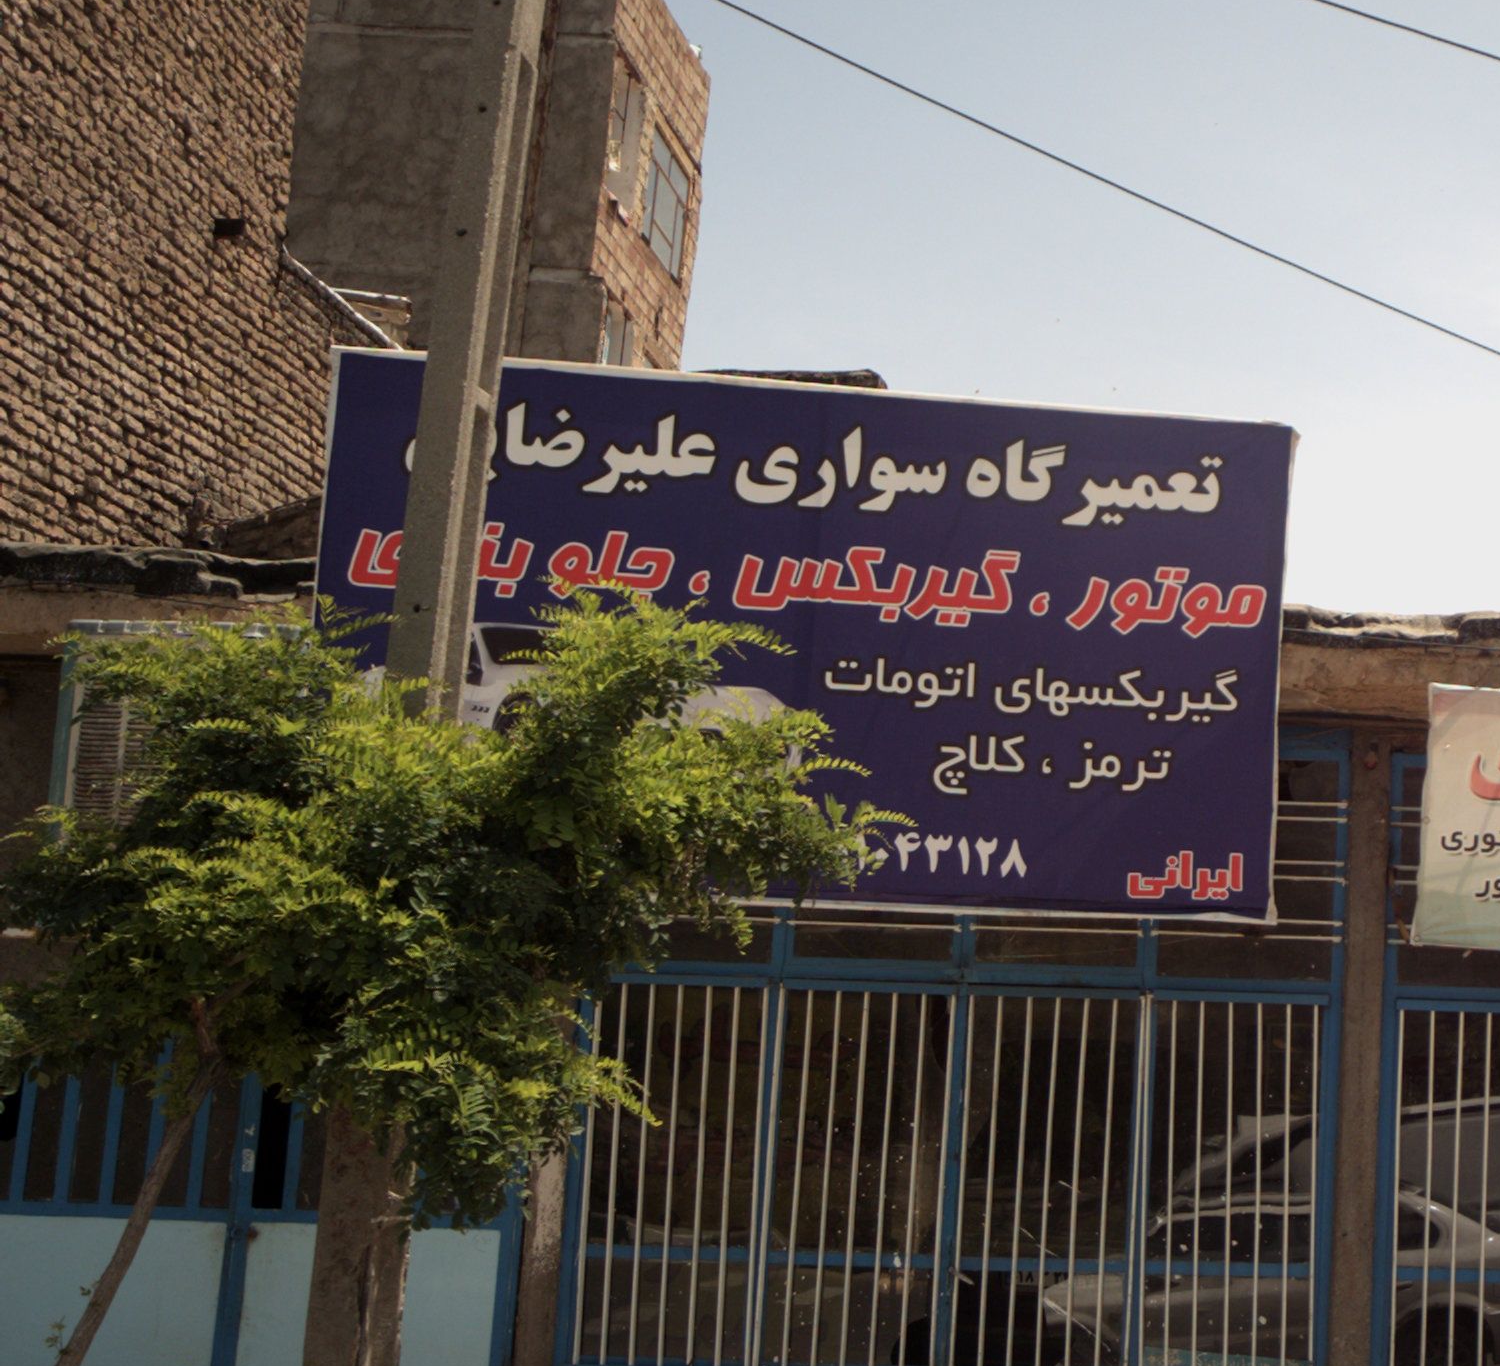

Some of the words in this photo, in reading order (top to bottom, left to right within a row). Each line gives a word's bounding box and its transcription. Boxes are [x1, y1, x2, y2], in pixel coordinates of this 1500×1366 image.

[405, 403, 716, 494] علیرضا
[737, 425, 945, 513] سواری
[733, 545, 1020, 626] گیربکس
[1067, 565, 1267, 637] موتور
[824, 656, 976, 710] اتومات
[995, 667, 1240, 725] گیربکسهای
[932, 733, 1026, 795] کلاچ
[1069, 740, 1170, 793] ترمز
[1127, 849, 1244, 900] ایرانی
